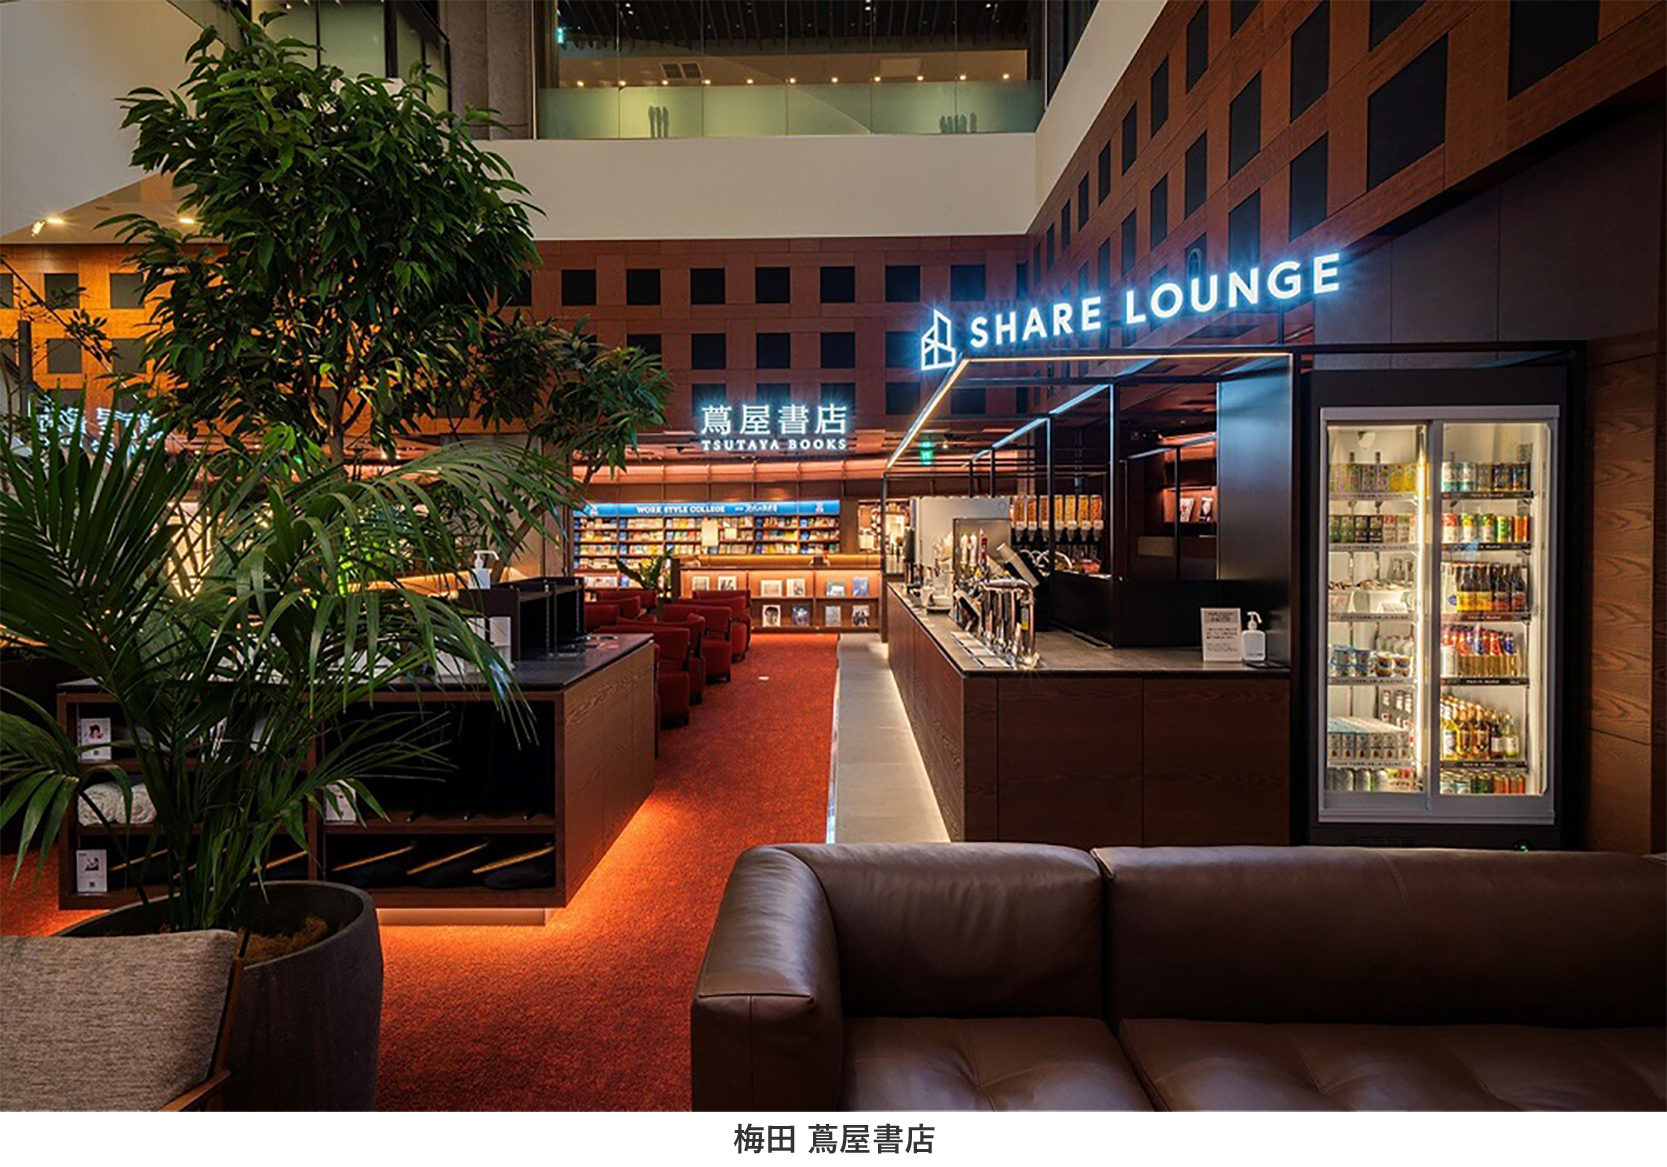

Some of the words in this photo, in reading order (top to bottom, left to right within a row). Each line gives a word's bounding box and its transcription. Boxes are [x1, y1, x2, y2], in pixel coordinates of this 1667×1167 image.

[969, 296, 1101, 348] SHARE
[1125, 252, 1340, 325] LOUNGE
[700, 403, 848, 435] 蔦屋書店
[701, 439, 780, 451] TSUTAYA
[788, 438, 847, 450] BOOKS
[636, 506, 662, 514] WORK
[689, 505, 726, 513] COLLEGE
